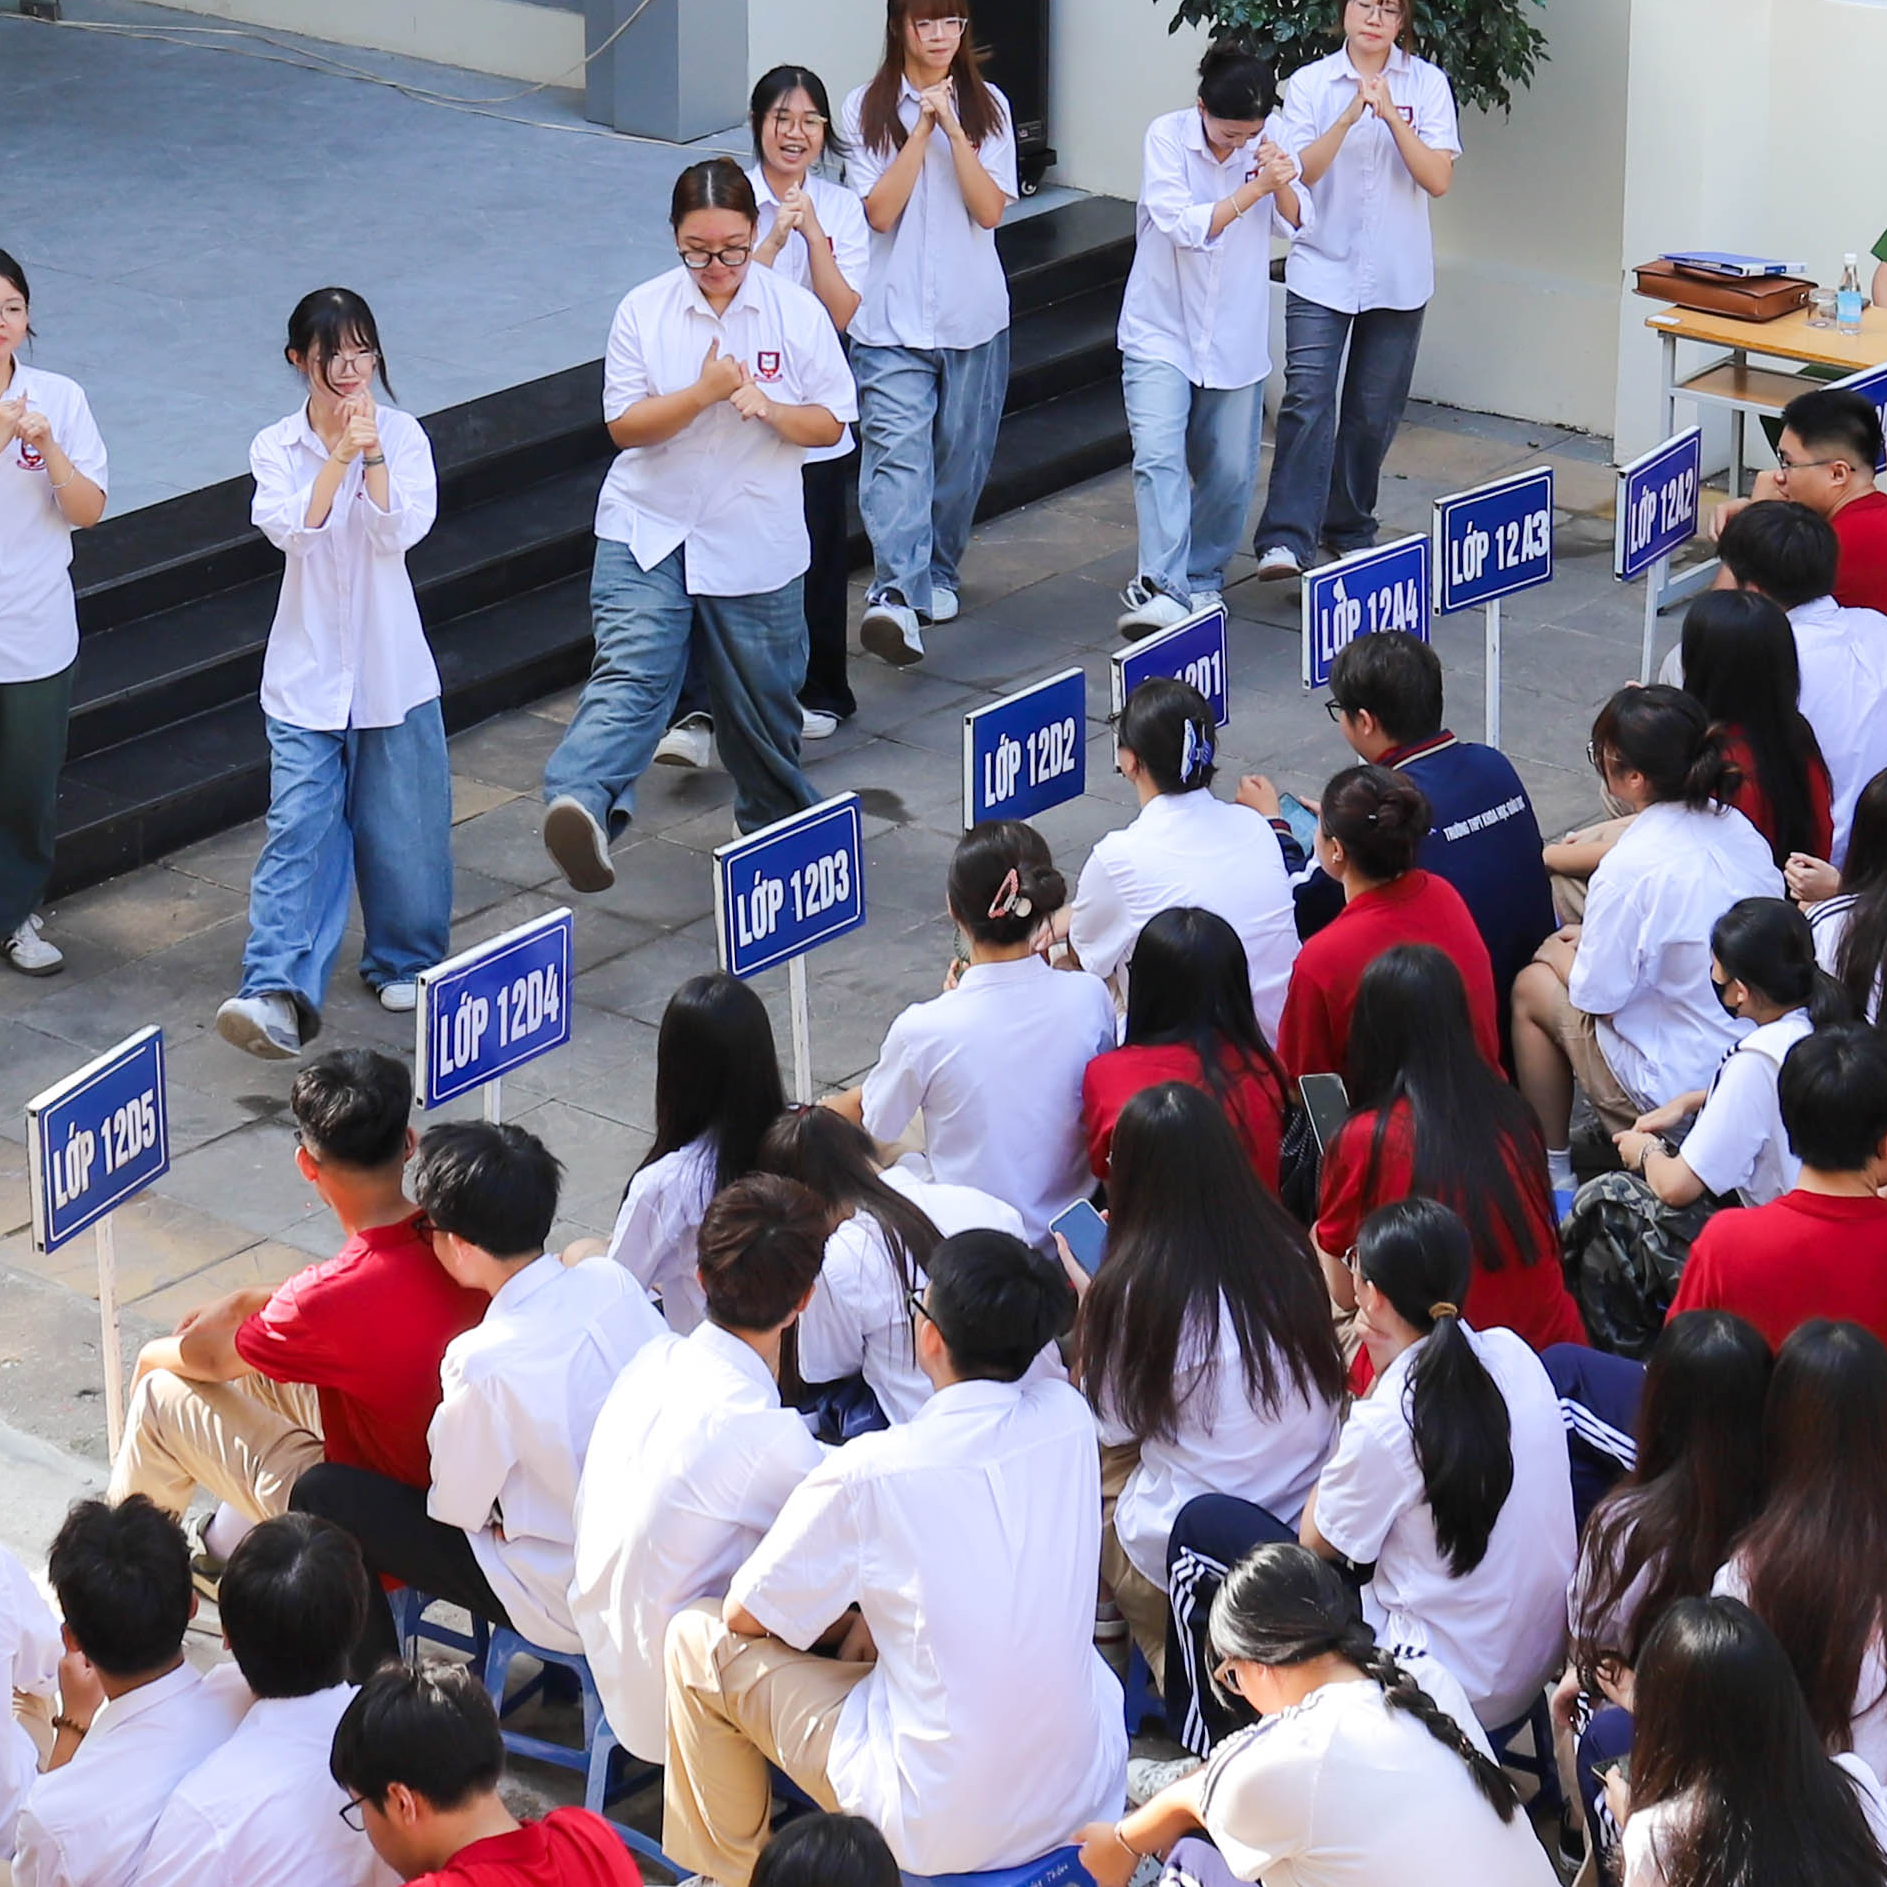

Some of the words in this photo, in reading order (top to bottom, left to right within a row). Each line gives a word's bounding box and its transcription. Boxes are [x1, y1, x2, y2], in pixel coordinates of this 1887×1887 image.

[1452, 520, 1489, 586] LỚP
[1629, 497, 1656, 555] LỚP
[1660, 469, 1694, 534] 12A2
[1322, 577, 1361, 662] LỚP
[1368, 578, 1418, 633] 12A4
[983, 731, 1023, 809] LỚP
[1026, 717, 1077, 789] 12D2
[736, 871, 785, 947] LỚP
[788, 849, 850, 922] 12D3
[438, 991, 491, 1079] LỚP
[495, 963, 560, 1048] 12D4
[51, 1129, 96, 1211] LỚP
[99, 1089, 156, 1175] 12D5
